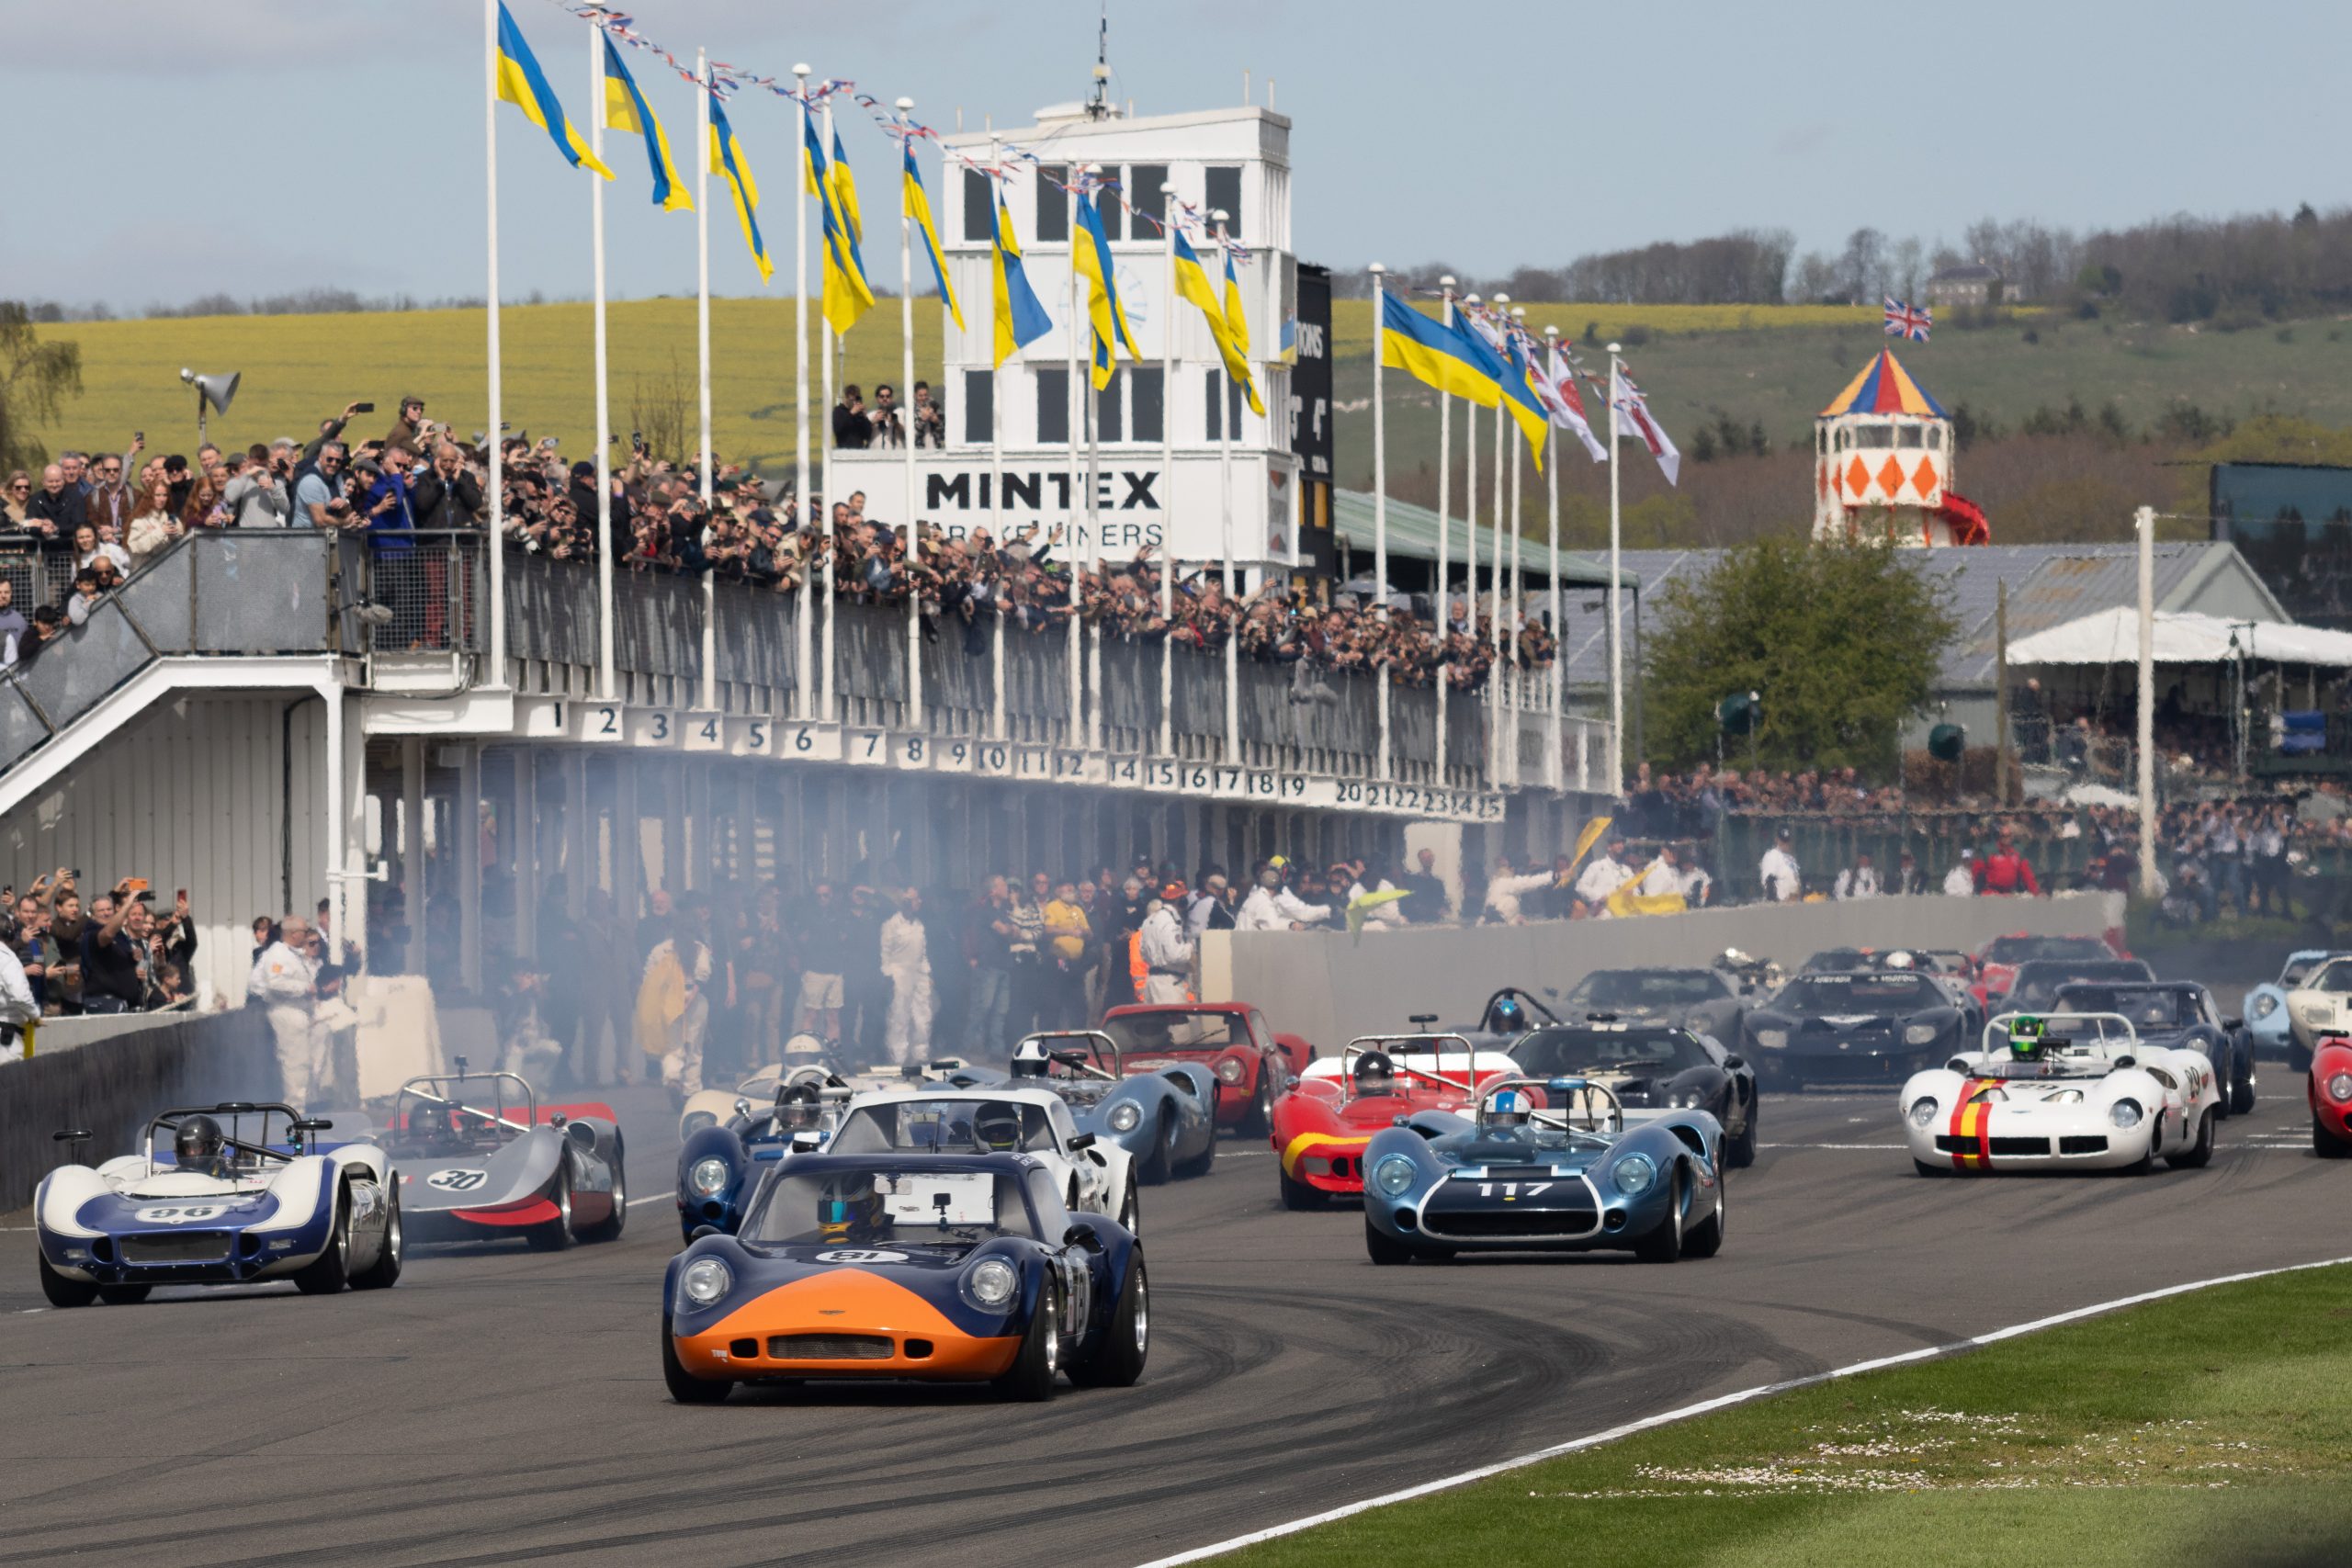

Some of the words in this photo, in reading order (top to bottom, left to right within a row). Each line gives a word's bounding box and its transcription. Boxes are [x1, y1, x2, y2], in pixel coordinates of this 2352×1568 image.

[927, 471, 1162, 510] MINTEX
[1047, 524, 1163, 546] LINERS
[554, 702, 561, 728] 1
[600, 707, 616, 733] 2
[651, 713, 668, 739] 3
[700, 717, 718, 742] 4
[749, 723, 764, 748] 5
[796, 727, 812, 750] 6
[864, 734, 879, 757] 7
[907, 738, 922, 761] 8
[952, 743, 966, 765] 9
[978, 747, 1005, 770] 10
[1022, 751, 1046, 773] 11
[1057, 754, 1082, 776] 12
[1110, 760, 1136, 781] 14
[1148, 763, 1172, 785] 15
[1181, 767, 1206, 788] 16
[1214, 770, 1239, 790] 17
[1249, 773, 1273, 794] 18
[1281, 777, 1306, 797] 19
[1336, 783, 1362, 803] 20
[1366, 784, 1391, 807] 21
[1394, 787, 1419, 808] 22
[1424, 792, 1448, 812] 23
[1452, 794, 1472, 815] 24
[1477, 795, 1500, 818] 25
[430, 1170, 485, 1190] 30
[1477, 1182, 1554, 1197] 117
[149, 1206, 214, 1219] 96
[829, 1251, 879, 1260] 81
